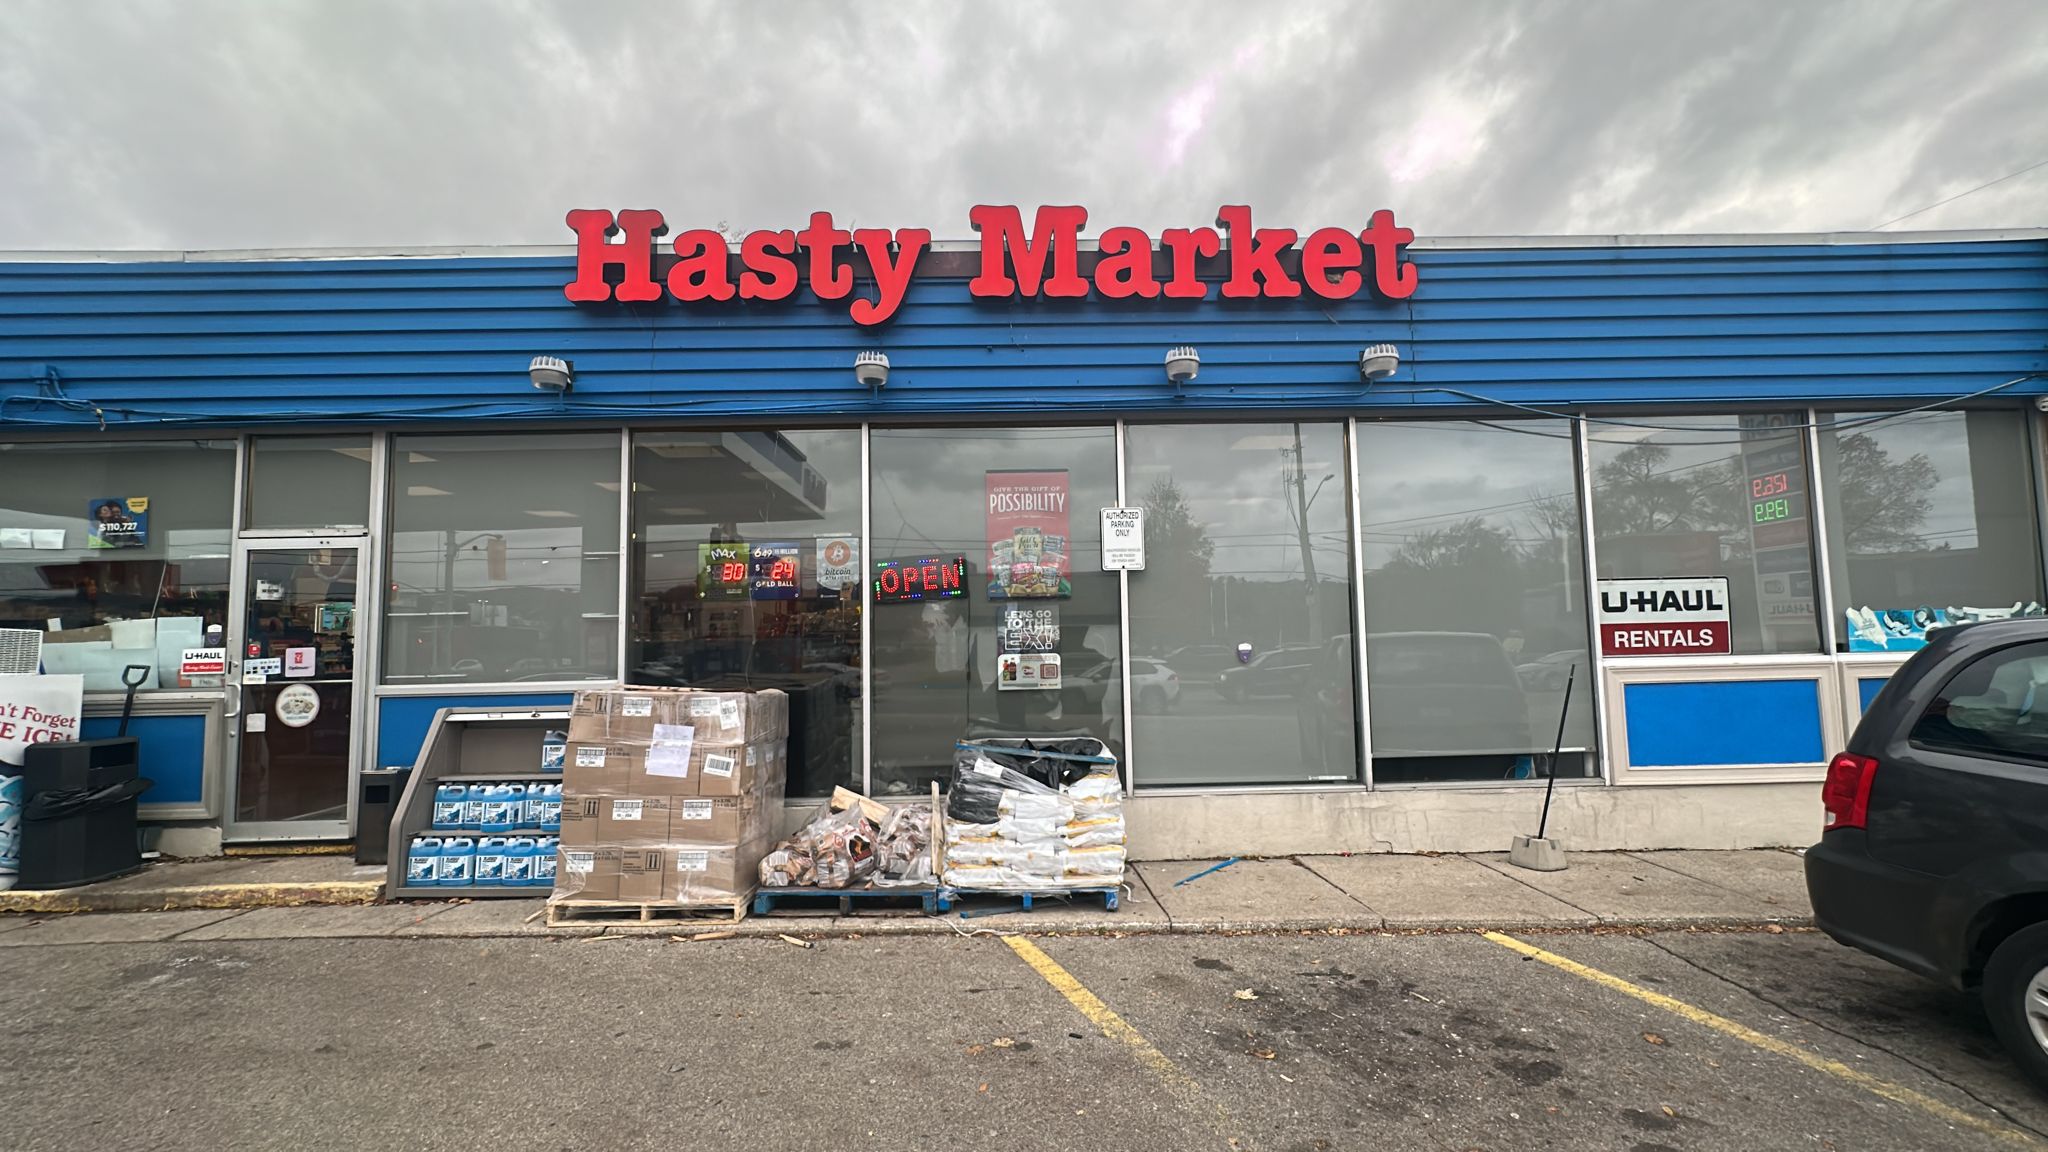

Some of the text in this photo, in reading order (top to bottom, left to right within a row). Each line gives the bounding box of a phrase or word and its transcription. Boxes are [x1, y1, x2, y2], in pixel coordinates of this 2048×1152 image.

[565, 205, 1419, 327] Hasty Market
[989, 493, 1065, 514] POSSIBILITY
[1106, 511, 1139, 519] AUTHORIZED
[1111, 520, 1135, 528] PARKING
[99, 522, 138, 531] $110,727
[1115, 529, 1130, 537] ONLY
[723, 563, 745, 582] 30
[772, 562, 794, 580] 24
[825, 567, 851, 575] bitcoin
[880, 562, 960, 593] OPEN
[1602, 589, 1723, 612] U-HAUL
[1005, 610, 1052, 619] LET'S GO
[1005, 619, 1052, 629] TO THE
[1005, 628, 1053, 650] EX!
[1614, 628, 1714, 649] RENTALS
[21, 706, 76, 728] Forget
